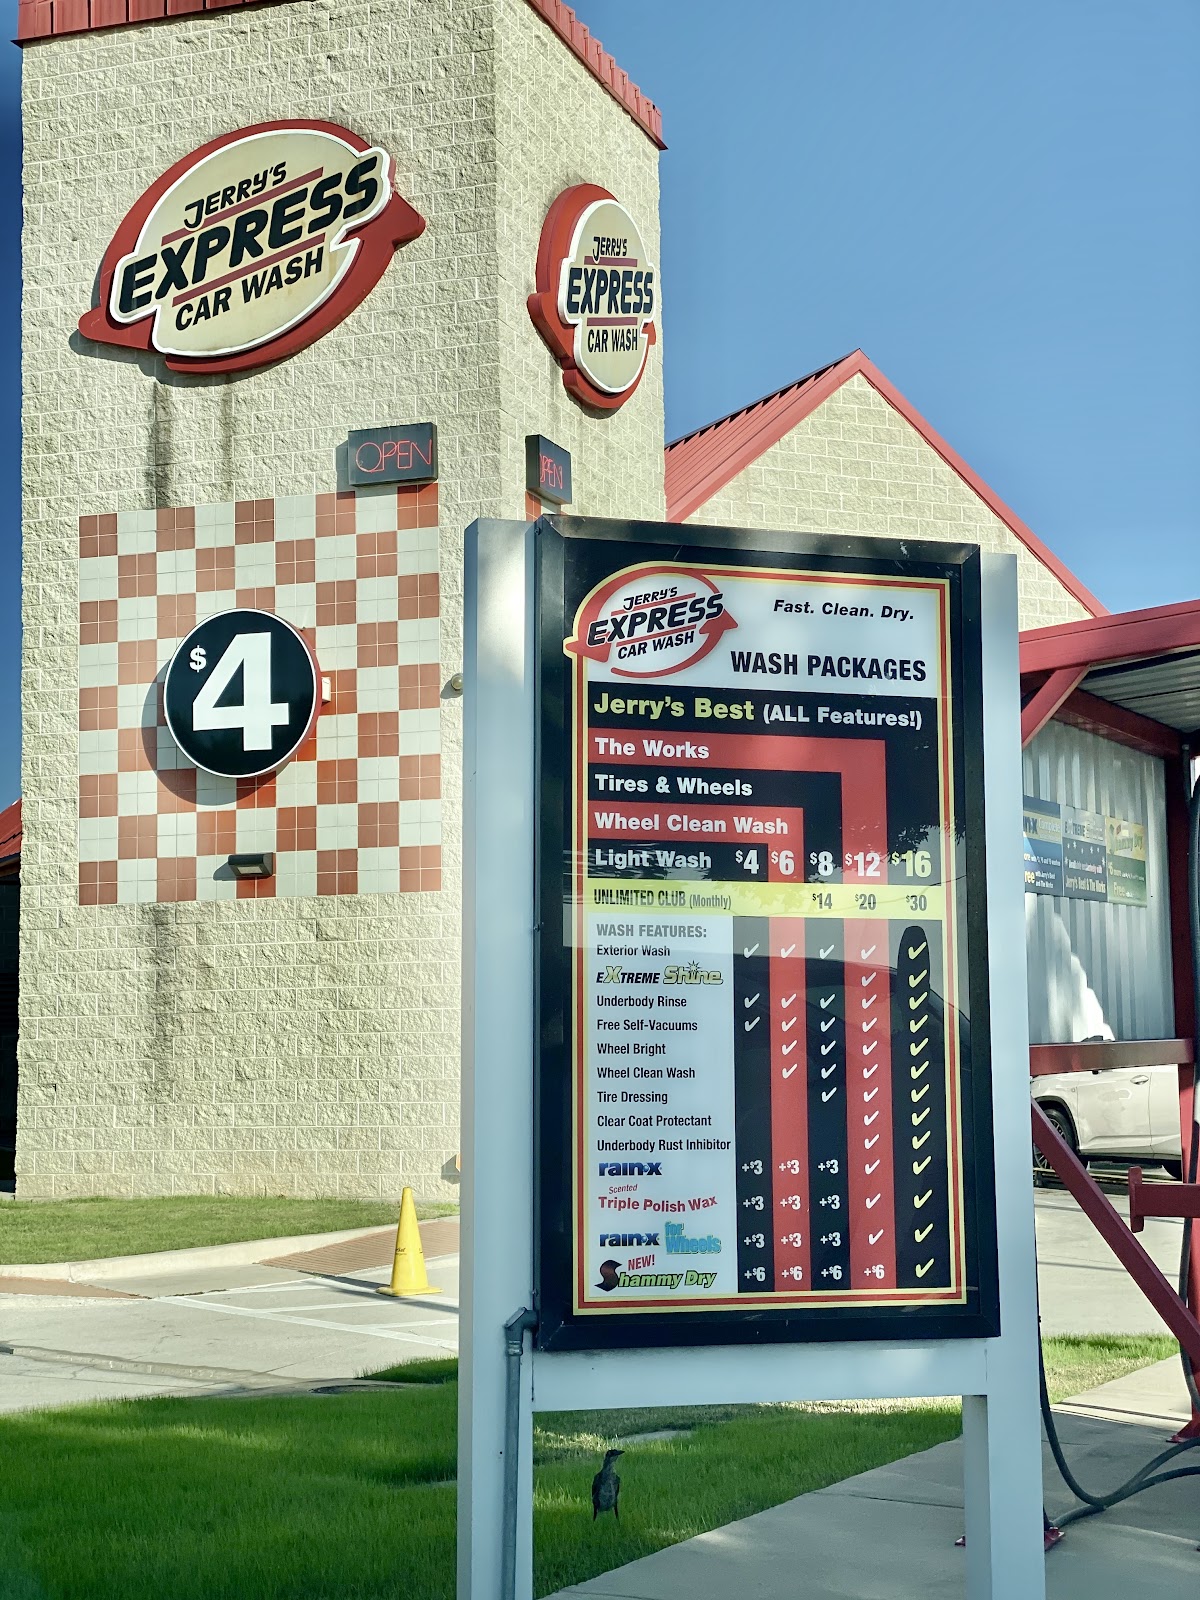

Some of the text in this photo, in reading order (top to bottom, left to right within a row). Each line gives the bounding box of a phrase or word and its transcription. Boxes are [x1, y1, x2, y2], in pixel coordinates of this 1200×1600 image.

[184, 162, 286, 229] JERRY'S
[118, 156, 378, 314] EXPRESS
[593, 236, 628, 260] JERRY'S
[176, 248, 323, 331] CAR WASH
[567, 267, 653, 315] EXPRESS
[587, 328, 638, 353] CAR WASH
[355, 439, 432, 473] OPEN
[623, 586, 678, 610] JERRY'S
[588, 593, 723, 647] EXPRESS
[774, 600, 914, 621] Fast. Clean. Dry.
[617, 631, 695, 660] CAR WASH
[731, 651, 926, 682] WASH PACKAGES
[594, 693, 922, 730] Jerry's Best (ALL Features!)
[595, 737, 710, 759] The Works
[595, 774, 752, 797] Tires & Wheels
[594, 812, 788, 834] Wheel Clean Wash
[595, 848, 932, 877] Light Wash $4 $6 $8 $12 $16
[1024, 870, 1036, 884] ree
[593, 889, 927, 912] UNLIMITED CLUB (Monthly) $14 $20 $30
[596, 923, 707, 938] WASH FEATURES:
[597, 944, 670, 957] Exterior Wash
[663, 963, 723, 985] Shine
[597, 995, 687, 1009] Underbody Rinse
[597, 1019, 698, 1031] Free Self-Vacuums
[597, 1043, 666, 1057] Wheel Bright
[597, 1067, 696, 1078] Wheel Clean Wash
[597, 1091, 668, 1104] Tire Dressing
[597, 1115, 712, 1127] Clear Coat Protectant
[597, 1139, 731, 1153] Underbody Rust Inhibitor
[608, 1184, 638, 1194] Scented
[598, 1196, 639, 1211] Triple
[643, 1199, 685, 1213] Polish
[688, 1196, 718, 1211] Wax
[665, 1221, 684, 1236] for
[665, 1234, 721, 1255] Wheels
[628, 1254, 655, 1271] NEW!
[594, 1259, 684, 1292] Shammy
[685, 1270, 717, 1290] Dry
